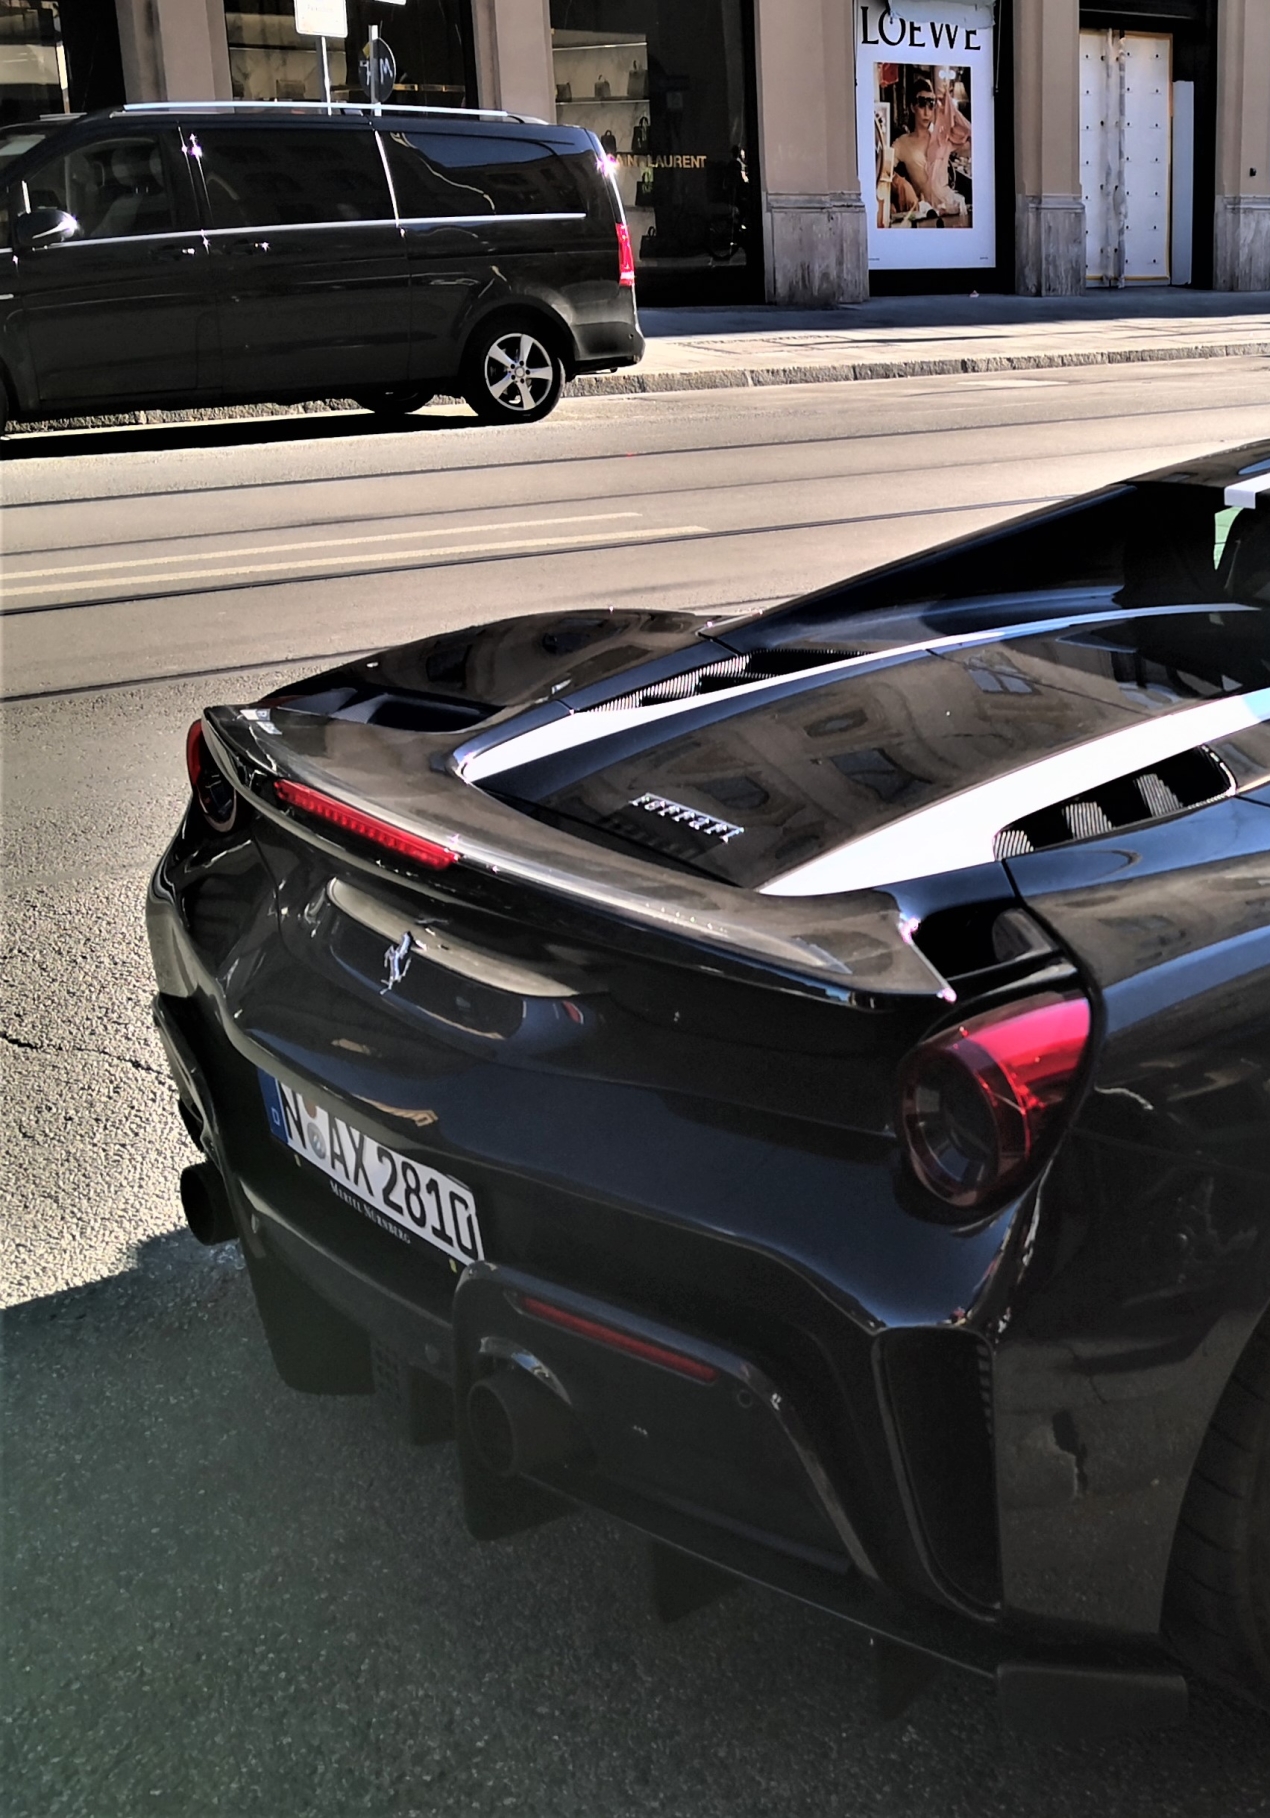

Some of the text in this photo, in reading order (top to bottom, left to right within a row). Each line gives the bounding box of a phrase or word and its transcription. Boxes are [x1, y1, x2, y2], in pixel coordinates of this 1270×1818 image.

[861, 6, 981, 51] LOEWE
[648, 154, 707, 169] LAURENT
[627, 792, 745, 844] Ferrari
[279, 1081, 479, 1261] N AX 2810
